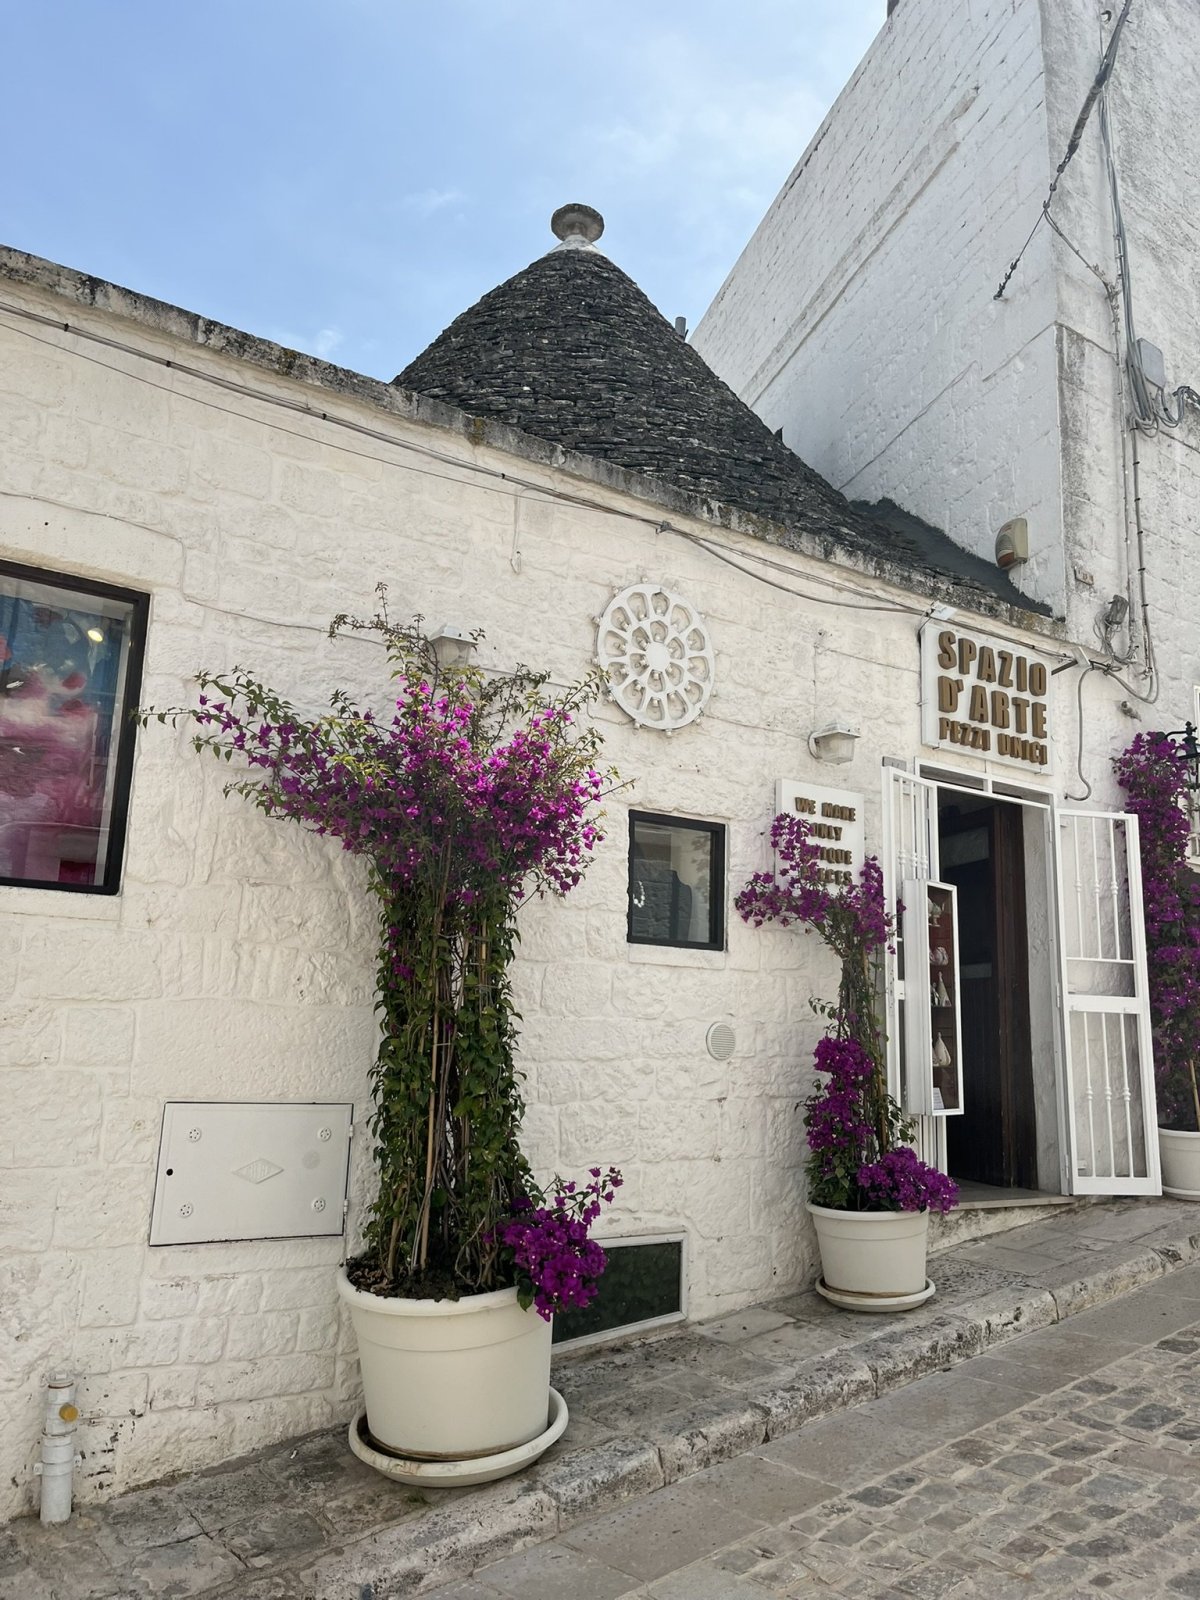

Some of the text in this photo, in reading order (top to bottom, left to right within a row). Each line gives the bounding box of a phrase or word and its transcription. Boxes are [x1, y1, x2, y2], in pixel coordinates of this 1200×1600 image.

[938, 631, 1046, 696] SPAZIO
[939, 717, 1047, 765] PEZZI UNICI
[795, 797, 856, 821] WE MAKE
[800, 844, 852, 865] IQUE
[800, 864, 852, 886] PECES
